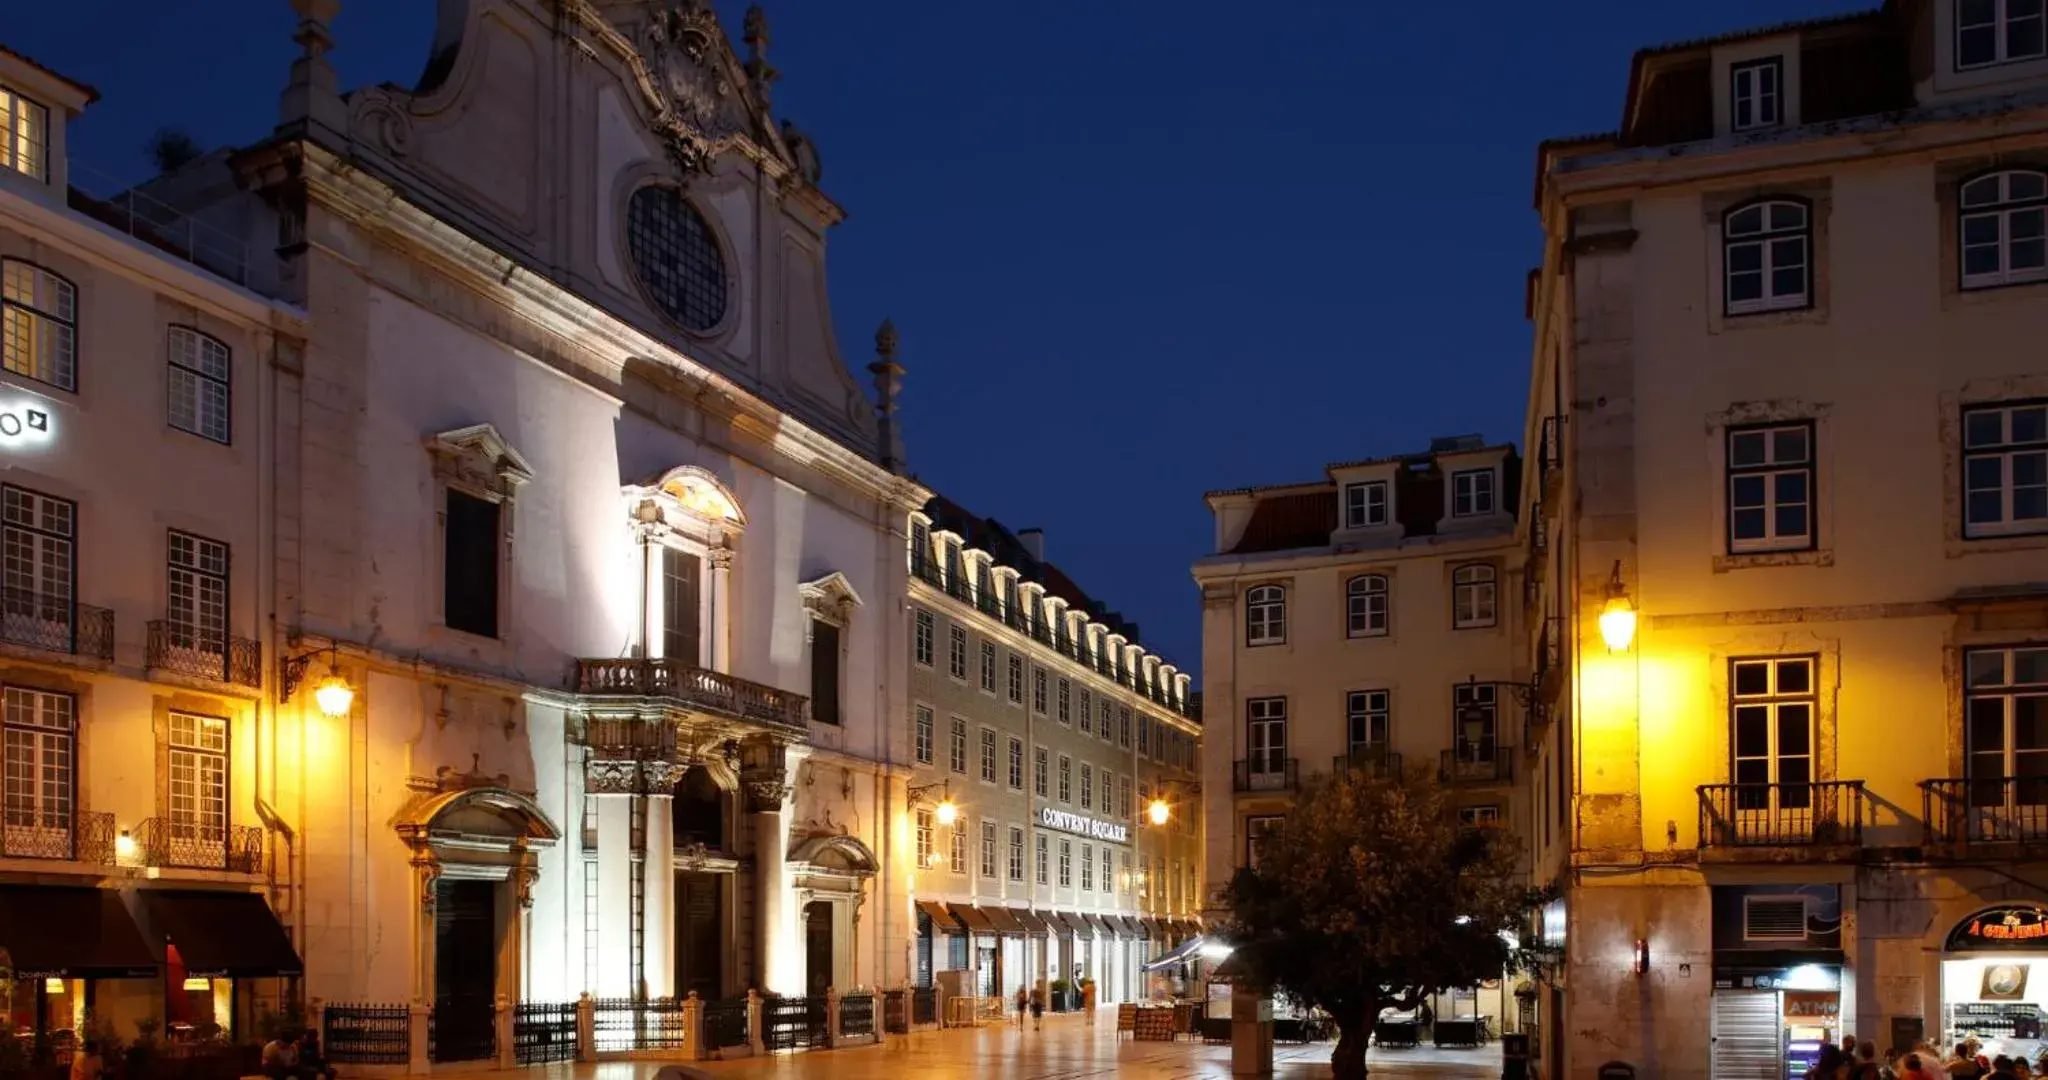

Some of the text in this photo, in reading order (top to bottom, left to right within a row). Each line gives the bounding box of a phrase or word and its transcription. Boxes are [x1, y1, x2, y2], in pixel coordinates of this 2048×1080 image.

[1042, 807, 1127, 841] CONVENT SQUARE
[1790, 1000, 1825, 1014] ATM
